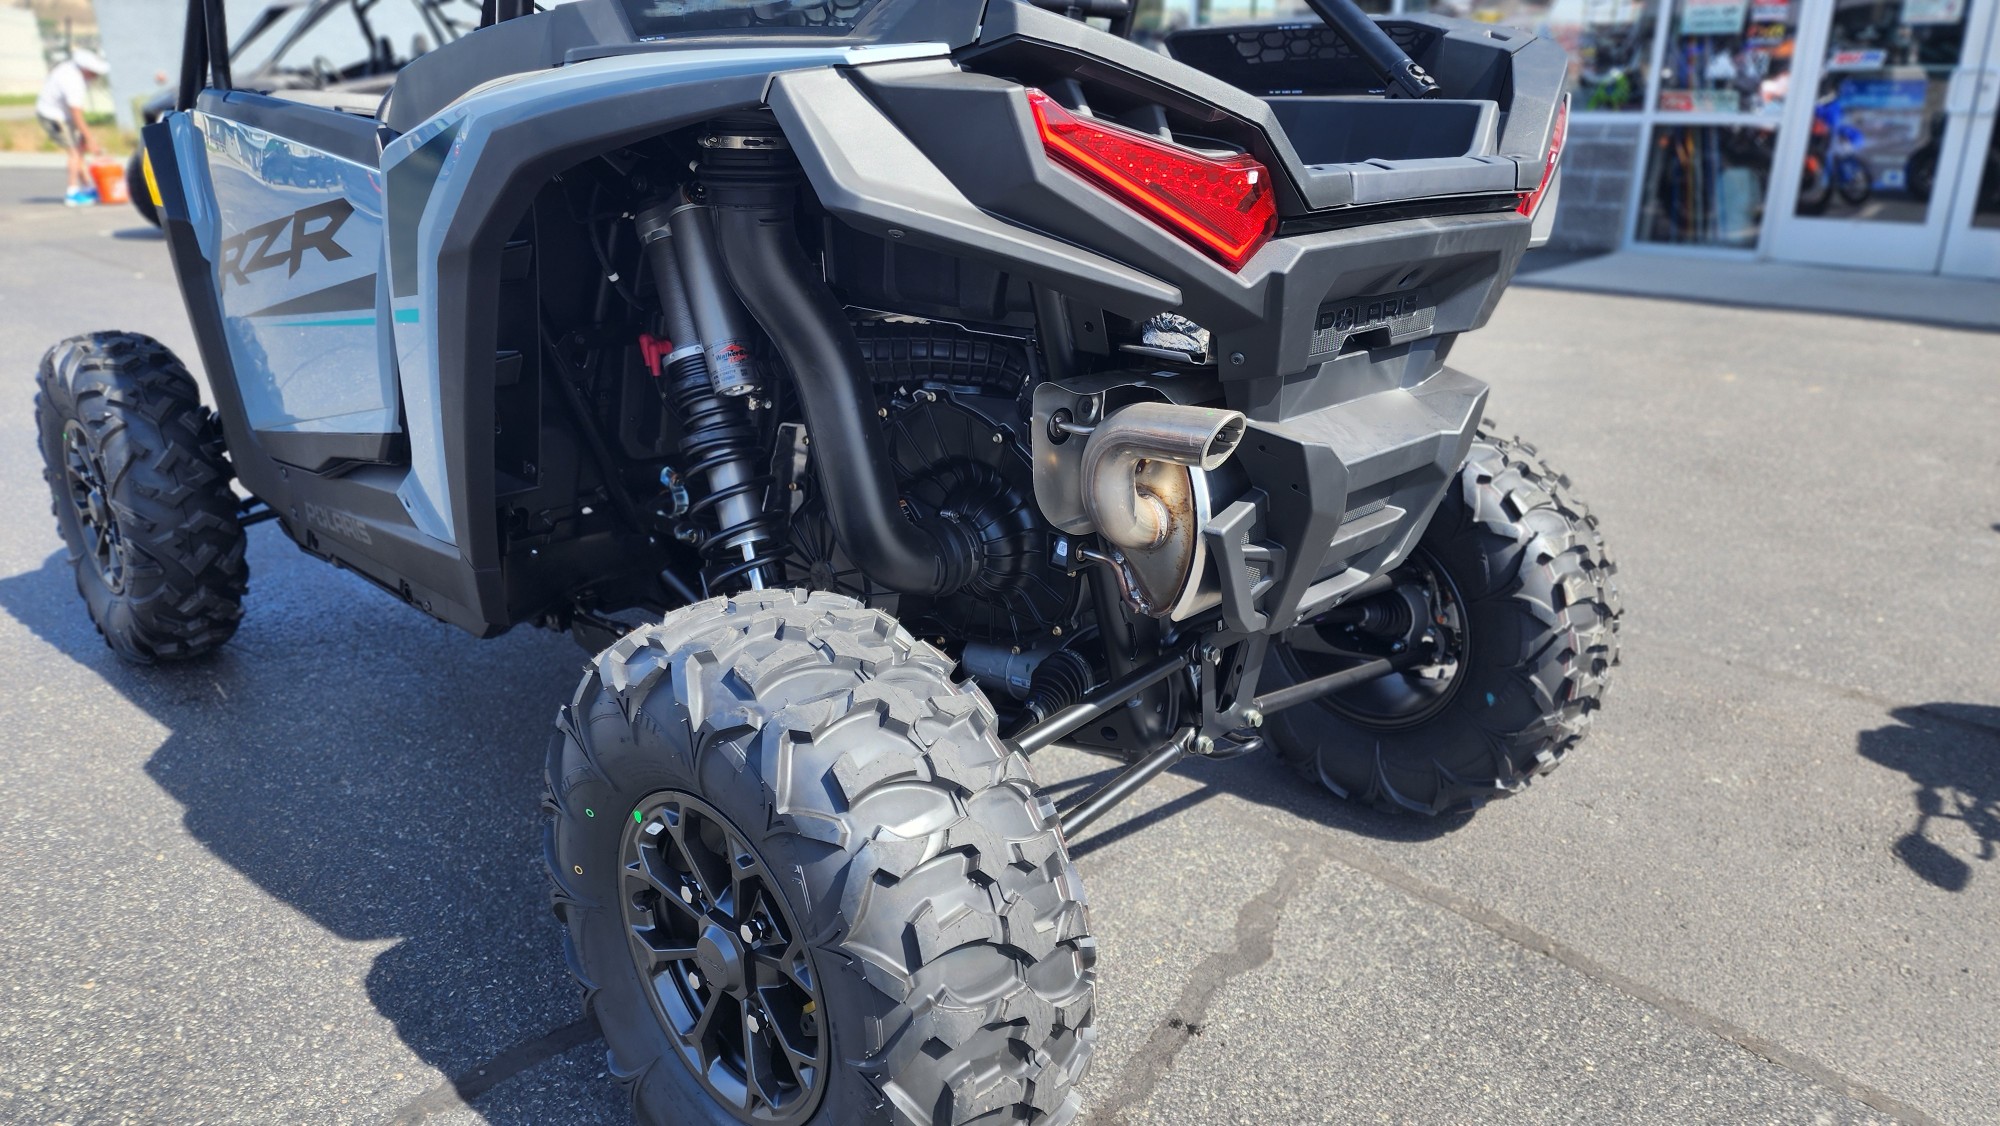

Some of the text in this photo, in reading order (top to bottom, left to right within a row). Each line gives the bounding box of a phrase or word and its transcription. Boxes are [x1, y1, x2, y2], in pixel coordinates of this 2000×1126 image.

[219, 197, 355, 291] RZR
[1314, 295, 1419, 337] POLARIS
[304, 502, 373, 545] POLARIS
